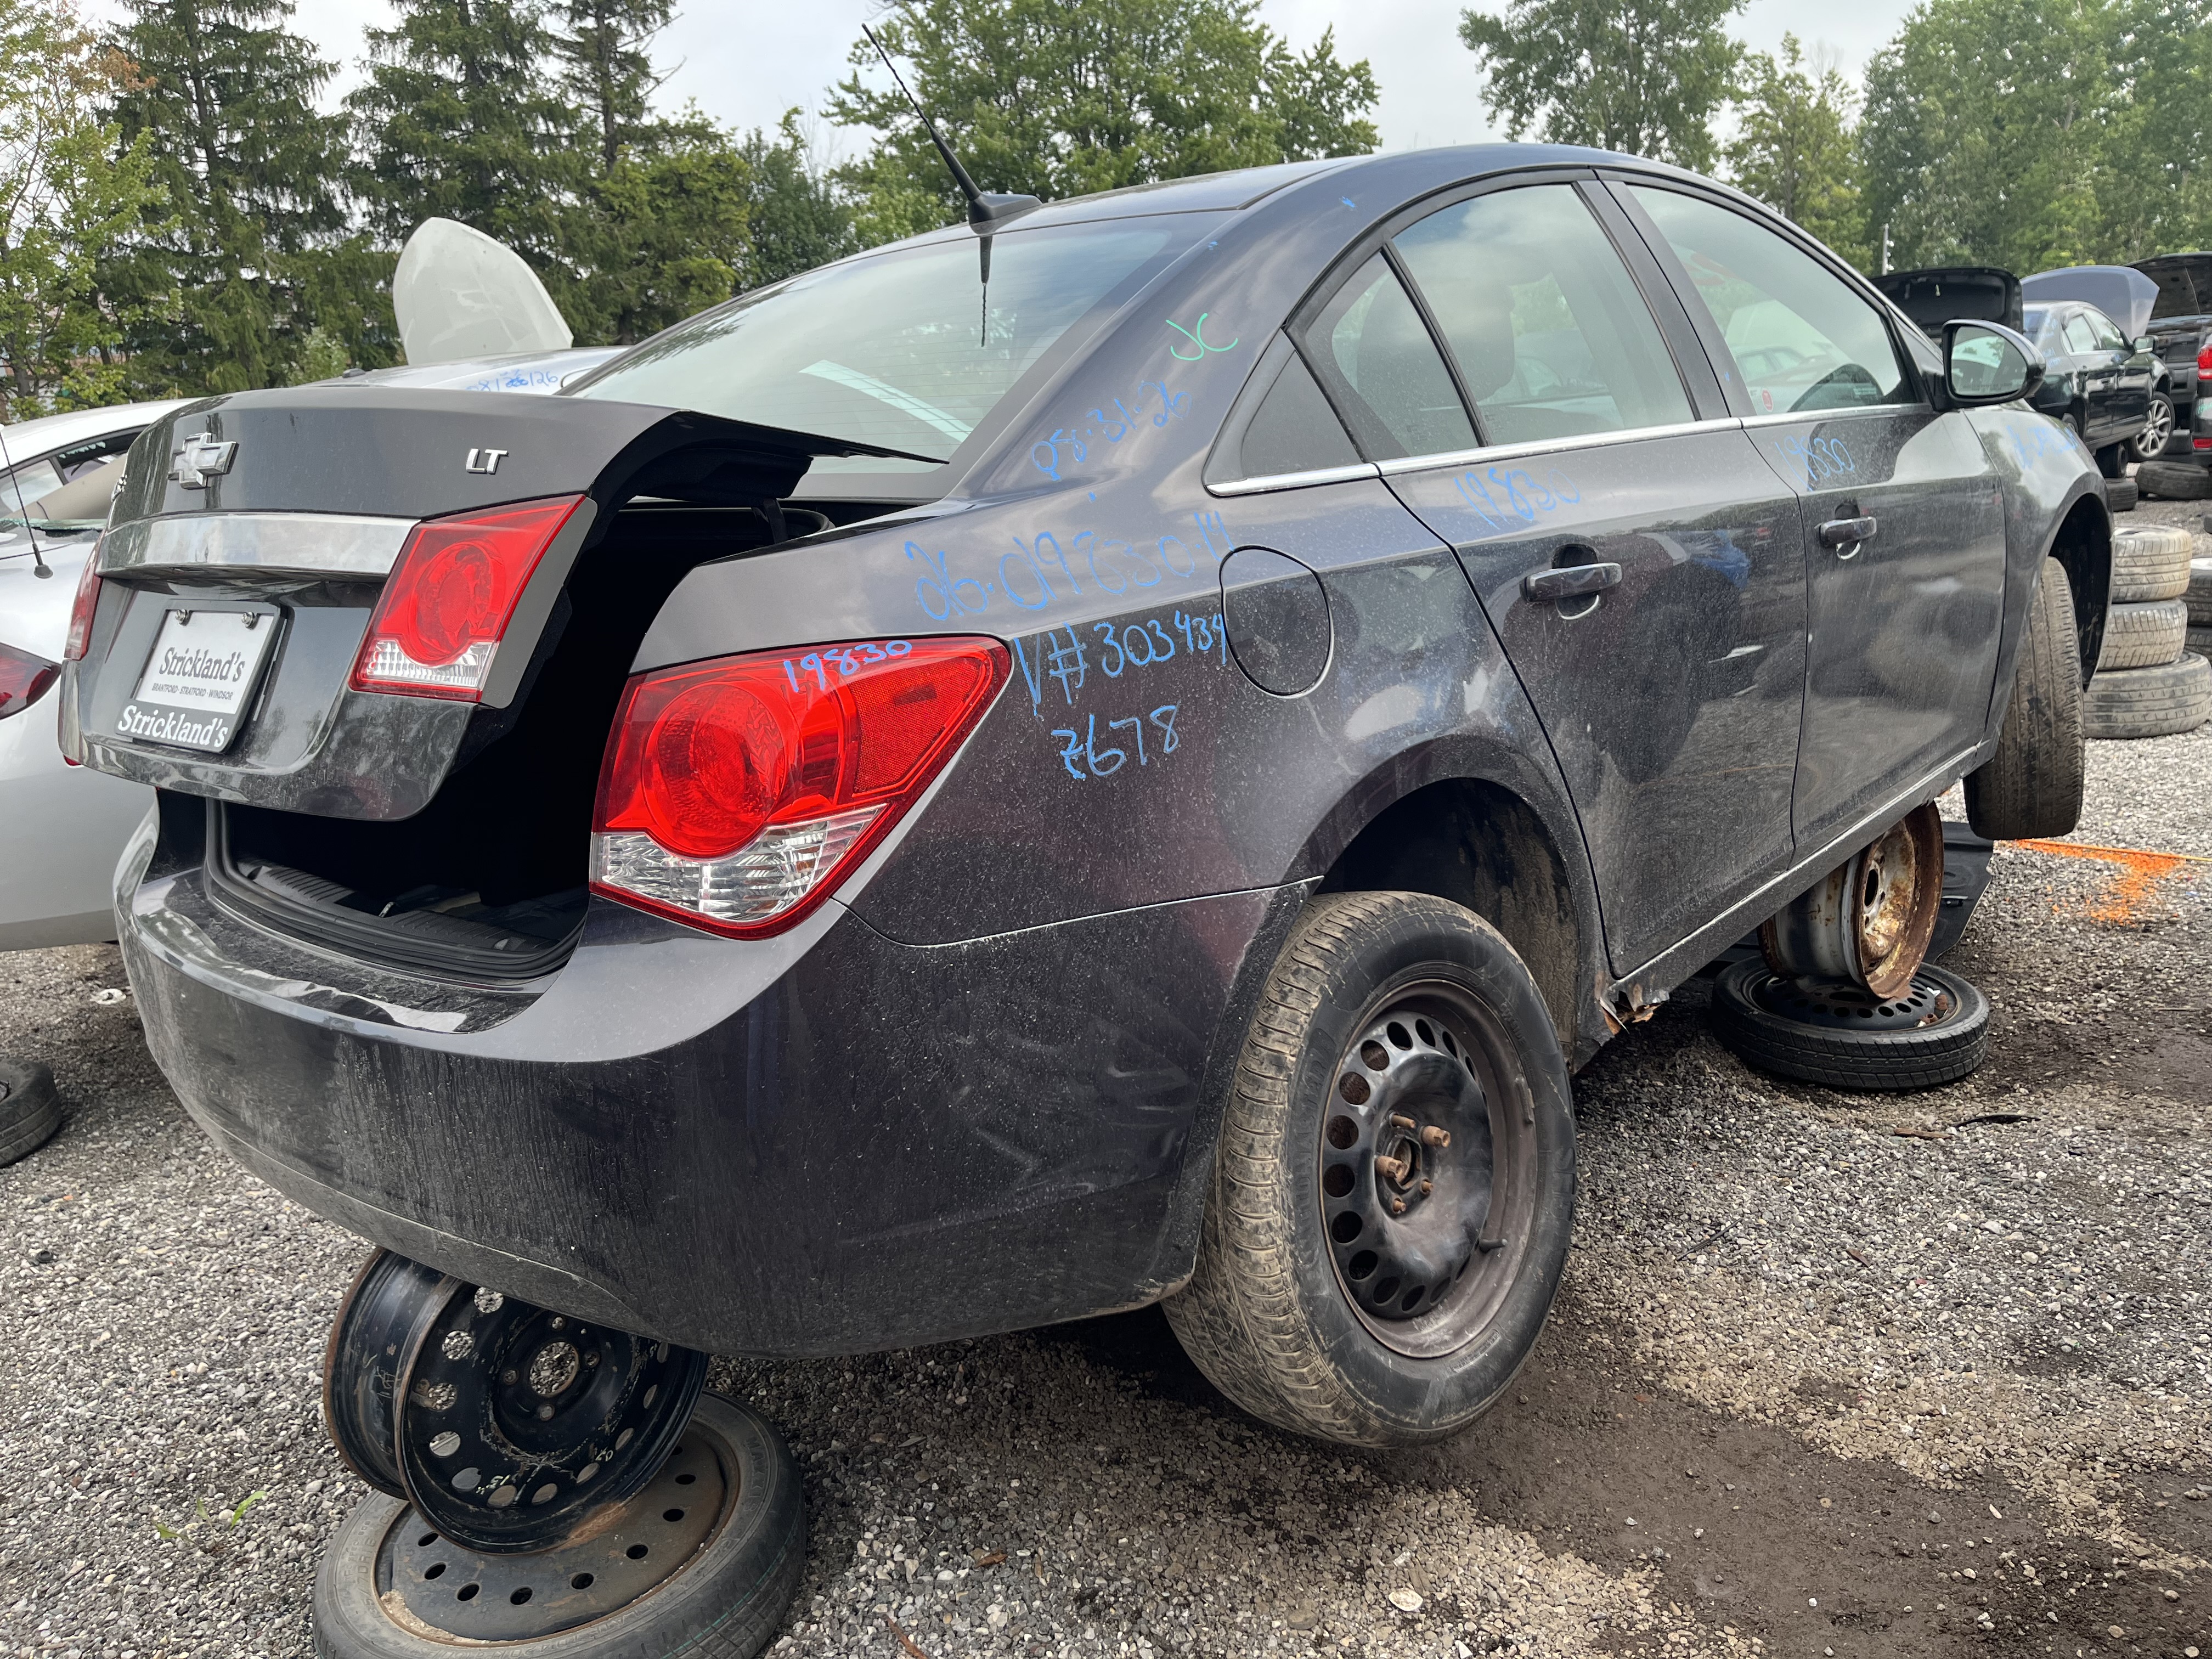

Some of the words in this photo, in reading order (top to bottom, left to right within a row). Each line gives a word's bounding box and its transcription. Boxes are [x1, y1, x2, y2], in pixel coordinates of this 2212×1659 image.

[465, 448, 508, 475] LT
[1454, 467, 1580, 528] 19830
[159, 647, 246, 682] Strickland's
[783, 640, 912, 692] 19830
[208, 689, 234, 700] WINDSOR
[117, 705, 228, 748] Strickland's
